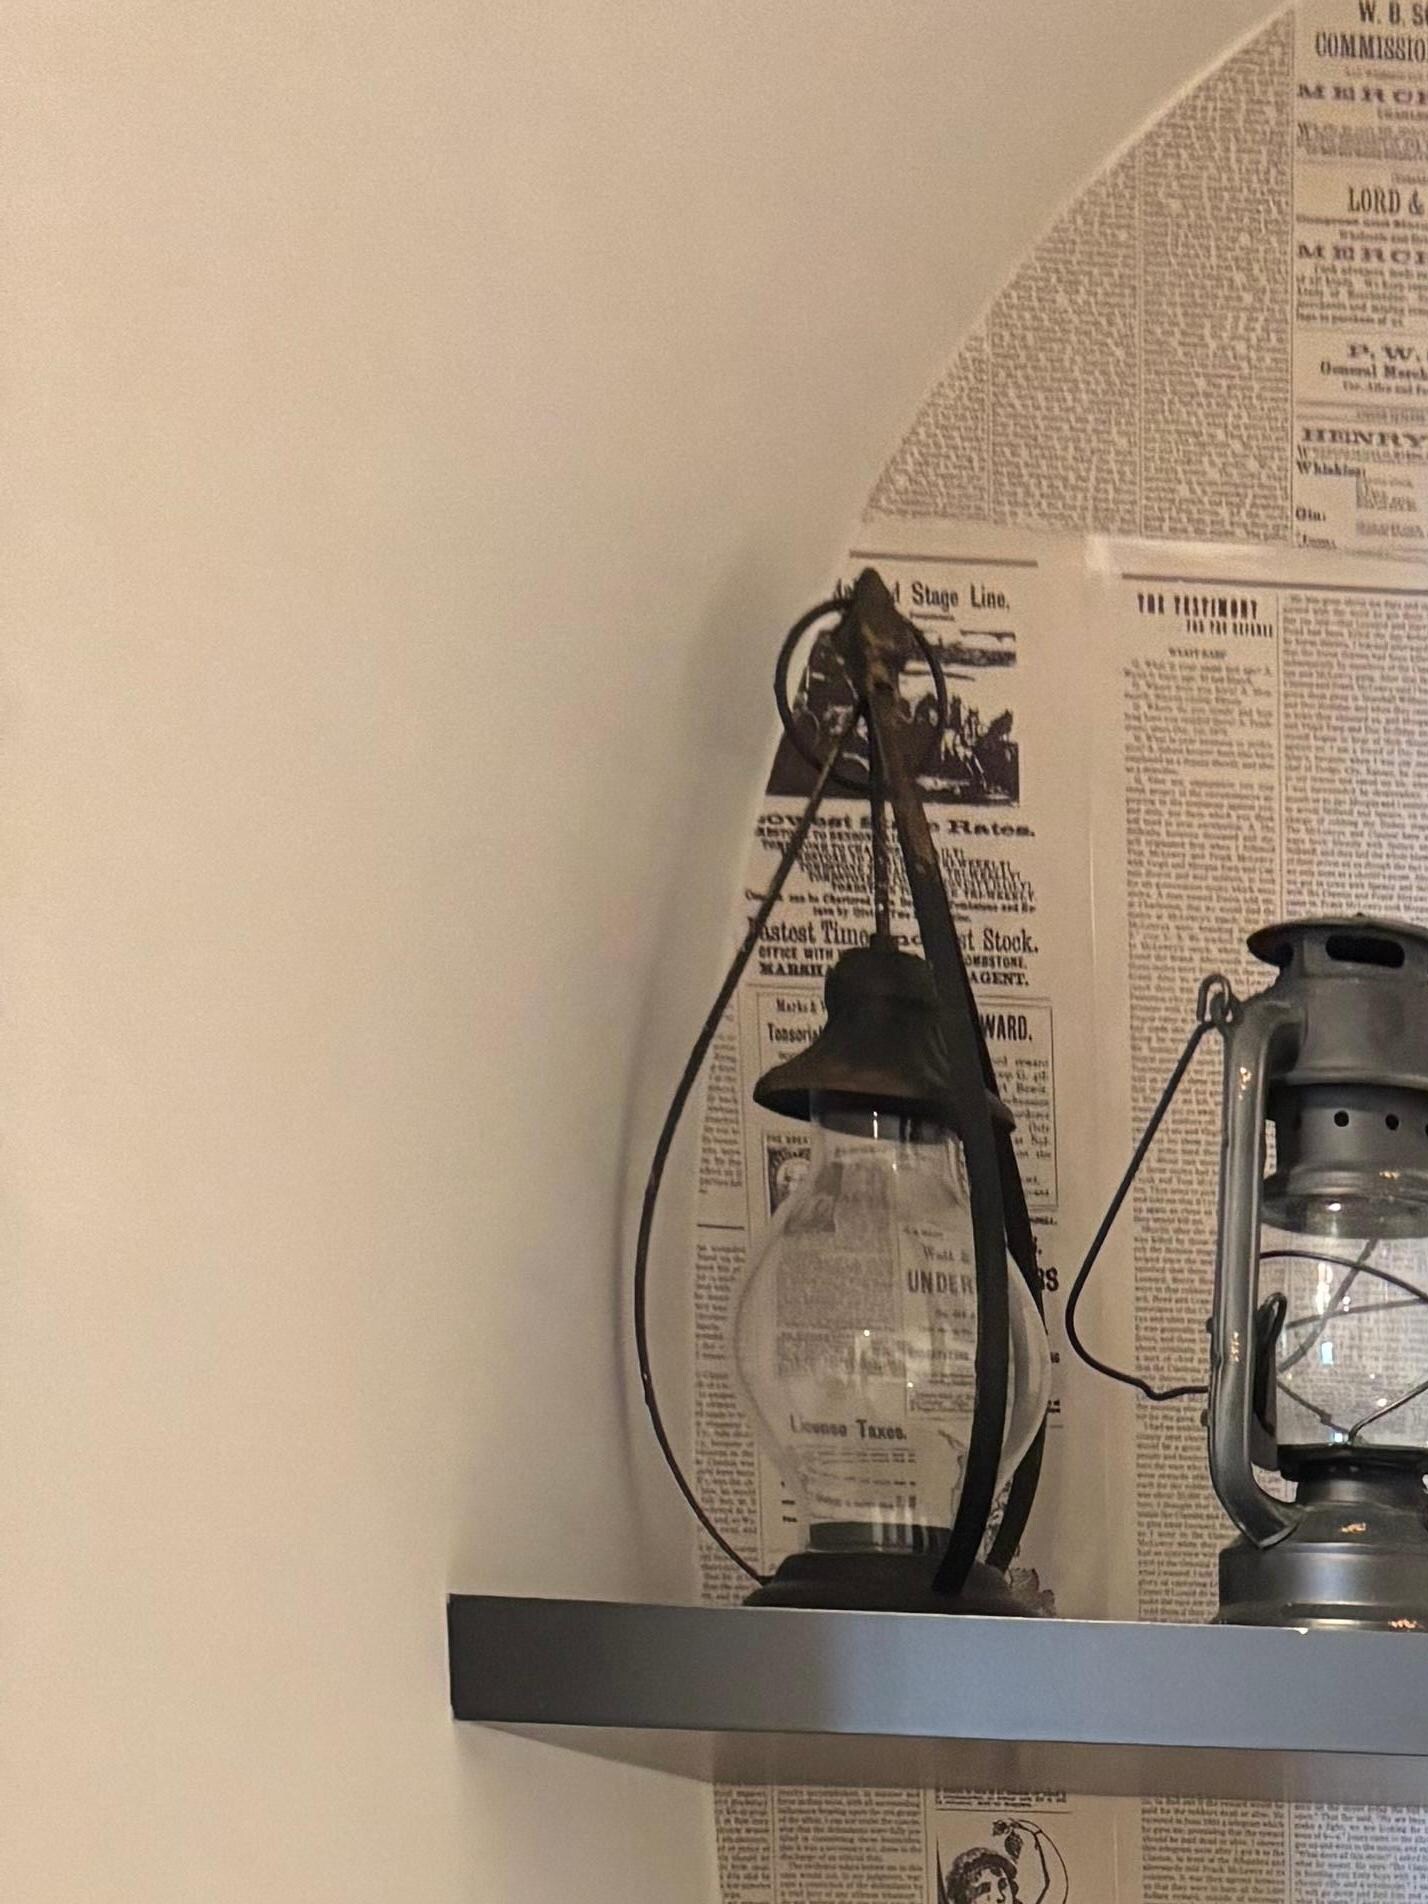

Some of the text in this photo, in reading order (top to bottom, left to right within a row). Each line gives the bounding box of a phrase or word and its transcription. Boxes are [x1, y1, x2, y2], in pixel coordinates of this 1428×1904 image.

[1349, 187, 1400, 214] LORD
[1409, 190, 1424, 215] &
[911, 581, 1011, 612] Stage Line.
